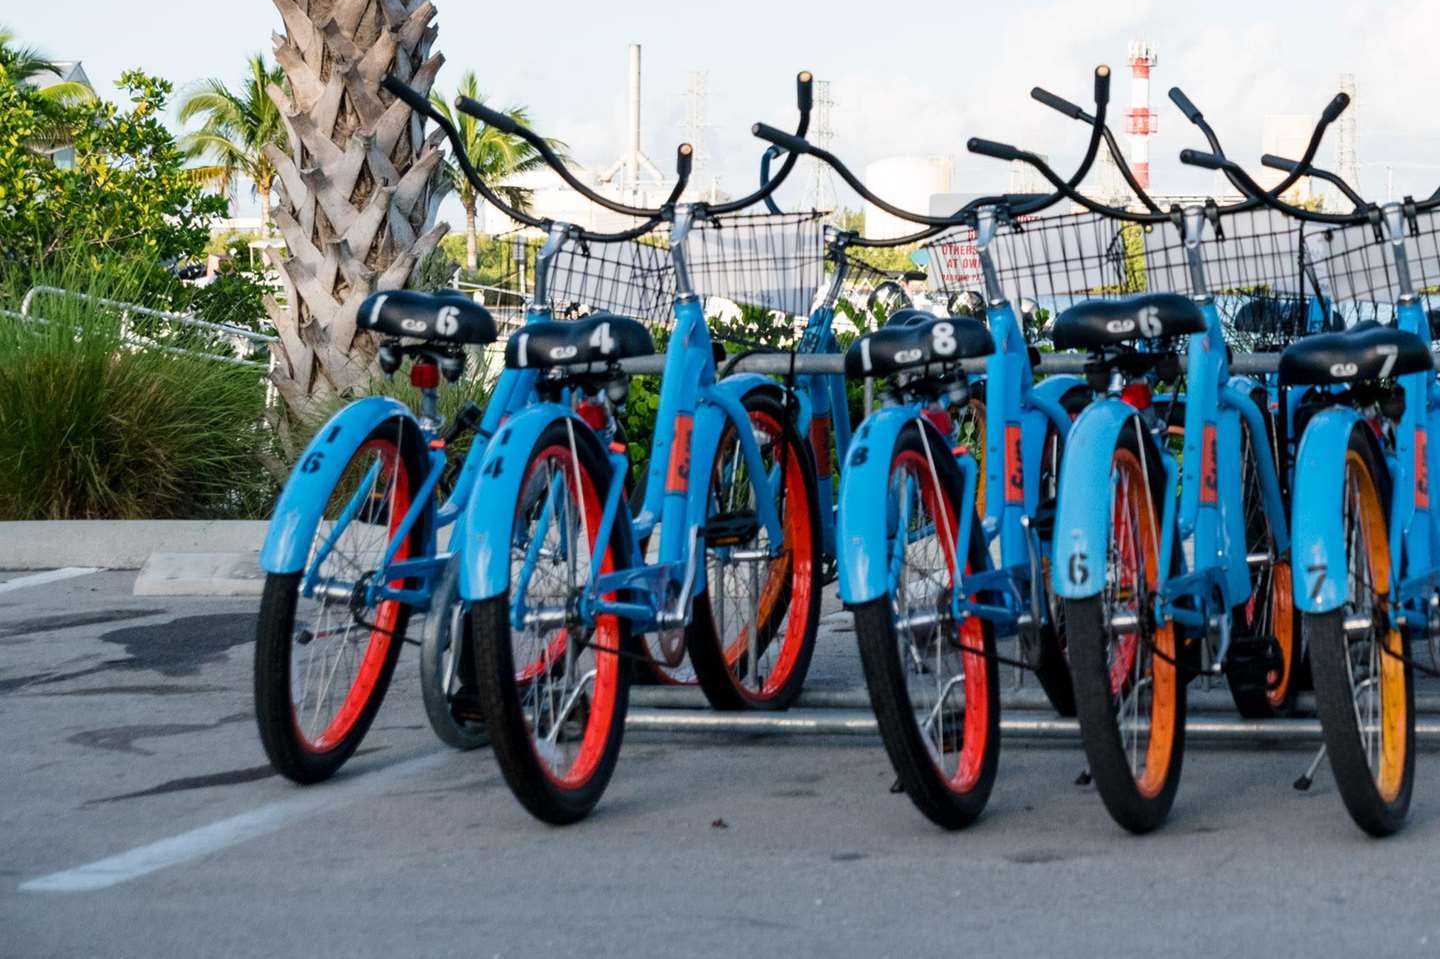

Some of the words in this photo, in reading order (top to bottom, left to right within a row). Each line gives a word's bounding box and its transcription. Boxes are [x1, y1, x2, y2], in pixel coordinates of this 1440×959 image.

[947, 259, 958, 268] AT
[1137, 306, 1162, 338] 6
[1375, 344, 1398, 379] 7
[1069, 552, 1088, 585] 6
[1307, 564, 1328, 599] 7
